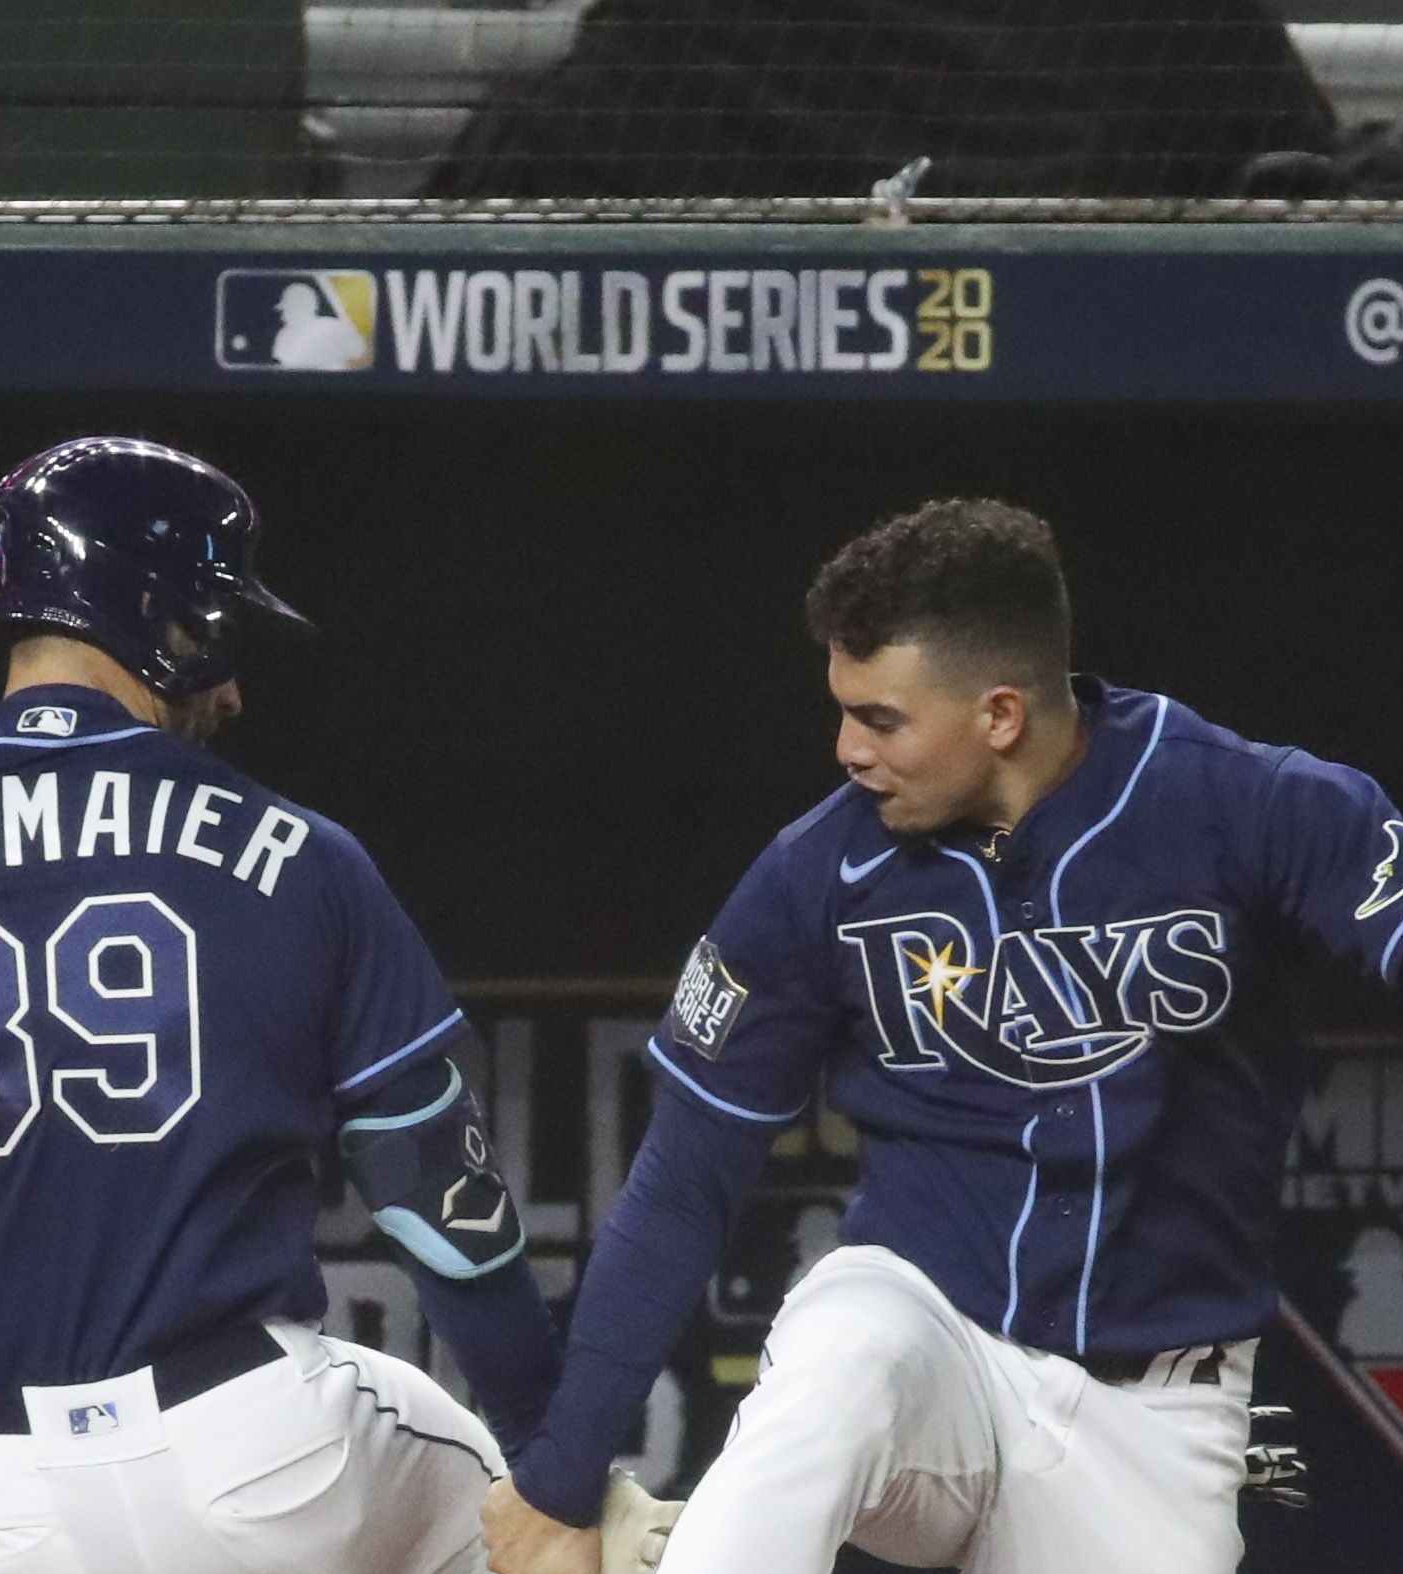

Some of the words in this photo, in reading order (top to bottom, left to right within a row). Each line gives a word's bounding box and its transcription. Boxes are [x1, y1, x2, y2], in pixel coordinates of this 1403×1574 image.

[387, 269, 649, 373] WORLD
[662, 270, 909, 373] SERIES
[918, 269, 992, 318] 20
[918, 321, 992, 372] 20
[838, 910, 1232, 1088] RAYS
